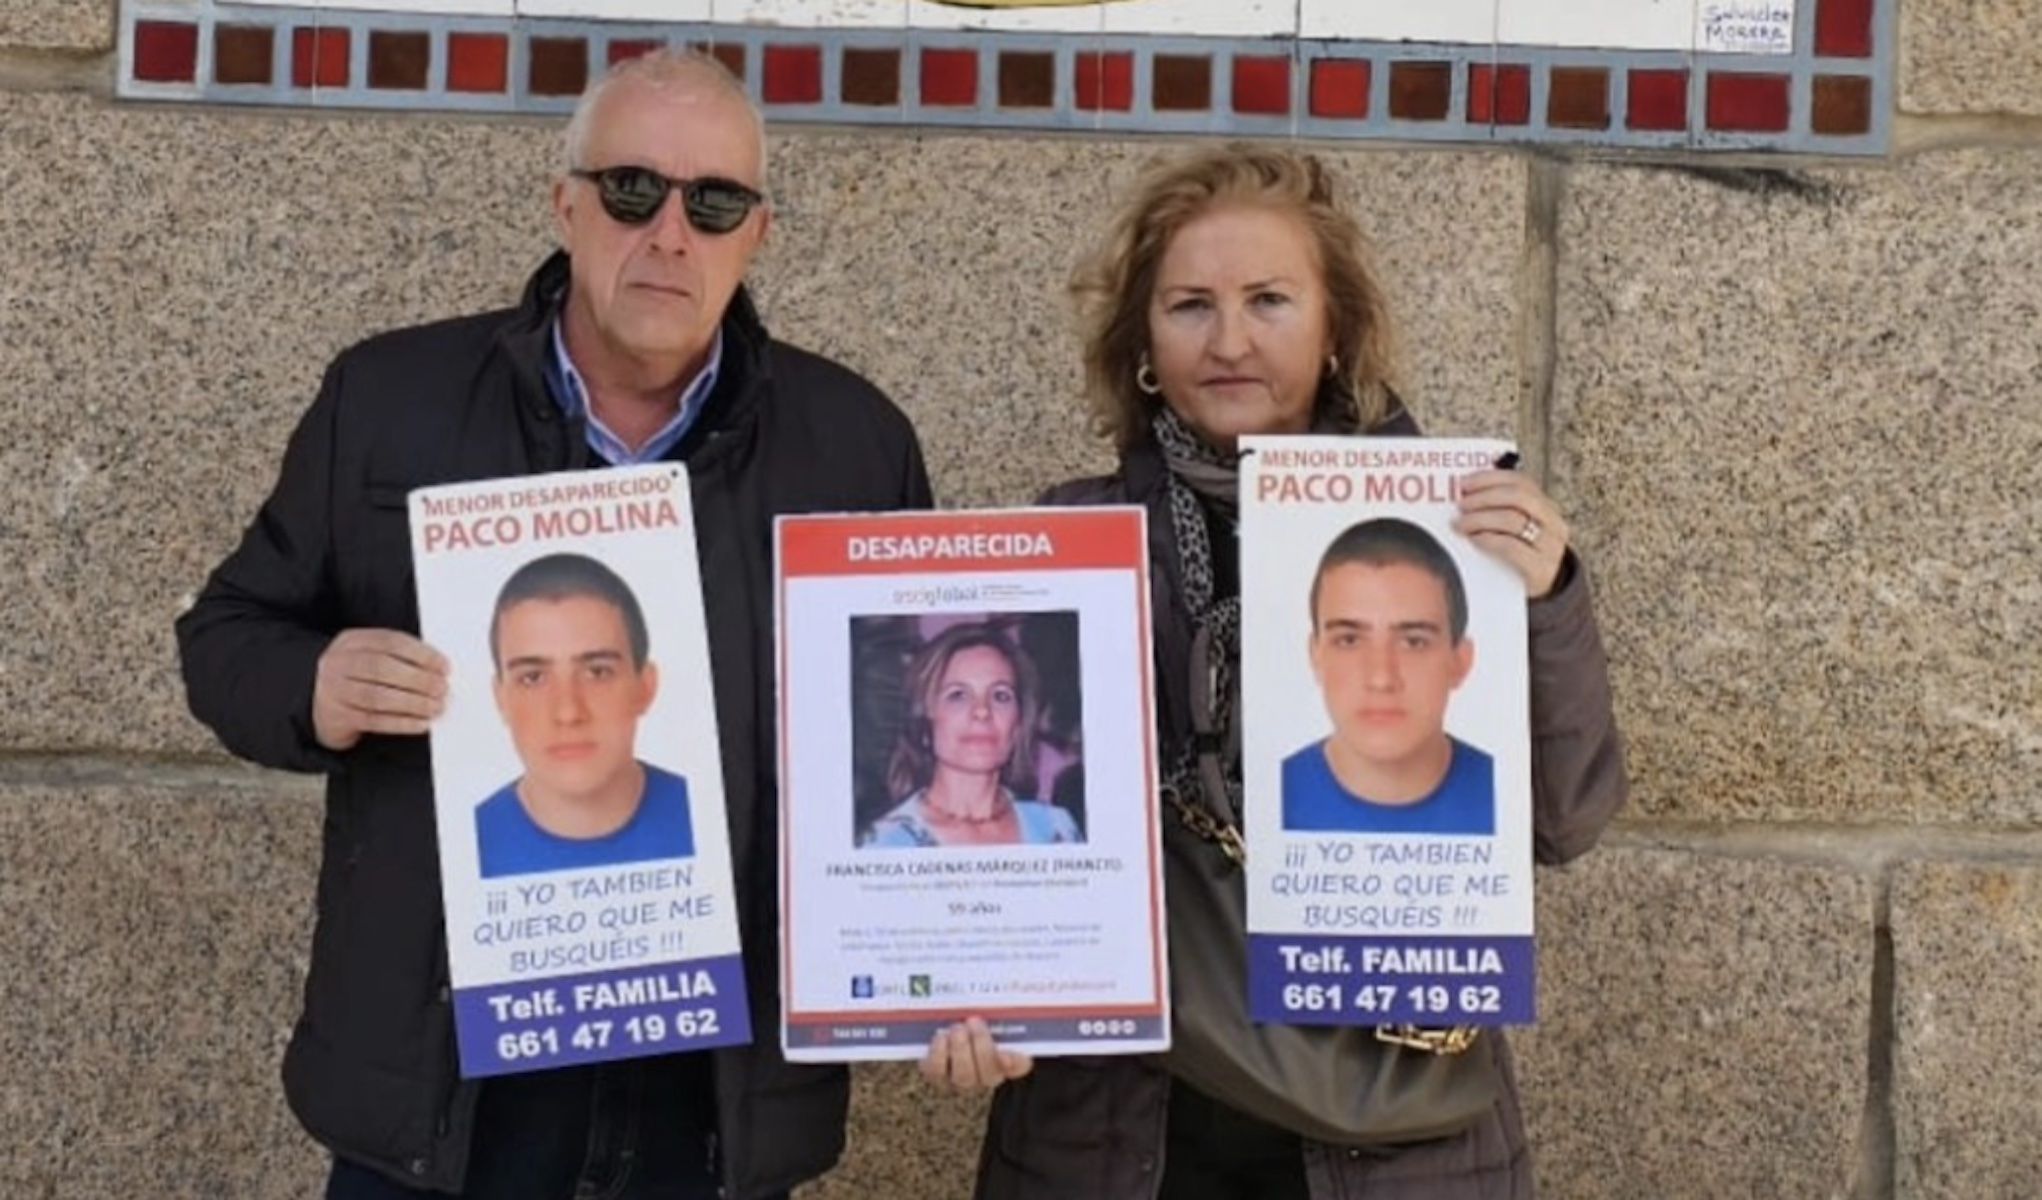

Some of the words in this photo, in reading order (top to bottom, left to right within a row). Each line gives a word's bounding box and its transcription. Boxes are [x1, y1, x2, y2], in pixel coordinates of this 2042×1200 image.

[1261, 450, 1338, 467] MENOR
[424, 492, 508, 517] MENOR
[510, 475, 671, 508] DESAPARECIDO
[1257, 474, 1352, 502] PACO
[1364, 474, 1457, 502] MOLI
[424, 516, 522, 551] PACO
[533, 499, 679, 540] MOLINA
[848, 533, 1055, 561] DESAPARECIDA
[1318, 842, 1353, 864] YO
[1364, 843, 1493, 865] TAMBIEN
[518, 883, 555, 906] YO
[568, 865, 694, 900] TAMBIEN
[1271, 875, 1381, 897] QUIERO
[1393, 875, 1454, 898] QUE
[1464, 875, 1510, 896] ME
[474, 911, 587, 946] QUIERO
[598, 903, 658, 930] QUE
[669, 895, 714, 920] ME
[1304, 899, 1442, 928] BUSQUÉIS
[1453, 906, 1478, 927] !!!
[509, 931, 649, 973] BUSQUÉIS
[660, 931, 684, 952] !!!
[1279, 946, 1351, 973] Telf.
[1362, 947, 1503, 974] FAMILIA
[488, 989, 565, 1022] Telf.
[573, 970, 717, 1011] FAMILIA
[1282, 984, 1342, 1010] 661
[1354, 985, 1397, 1012] 47
[1408, 985, 1449, 1012] 19
[1459, 985, 1502, 1012] 62
[497, 1027, 559, 1060] 661
[571, 1021, 613, 1049] 47
[625, 1014, 666, 1044] 19
[676, 1008, 719, 1038] 62
